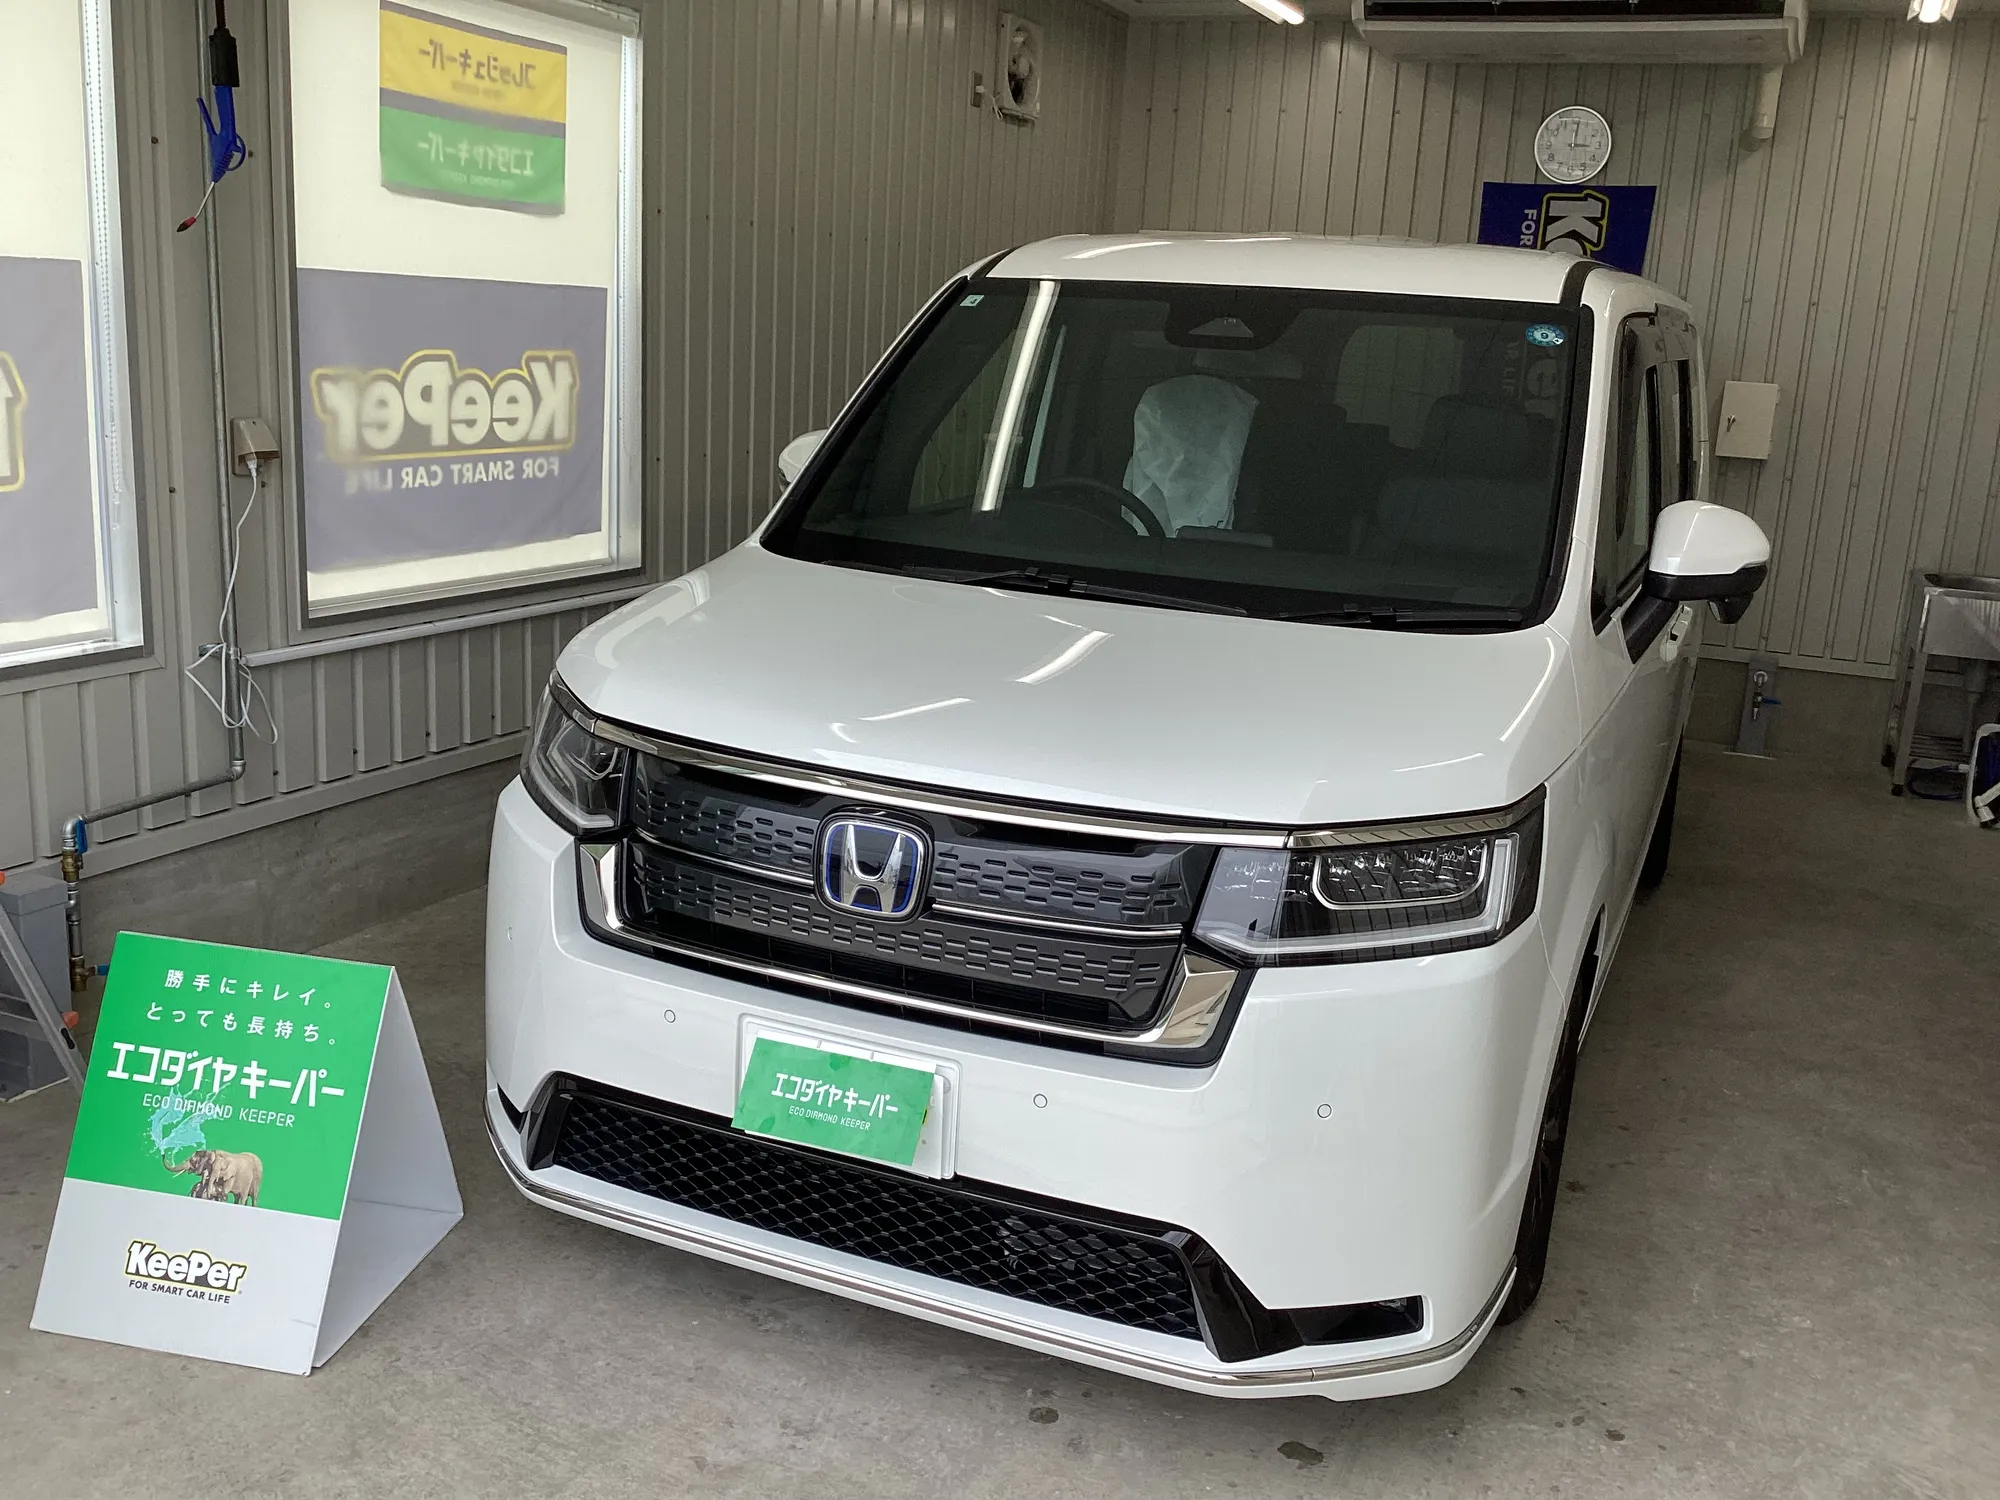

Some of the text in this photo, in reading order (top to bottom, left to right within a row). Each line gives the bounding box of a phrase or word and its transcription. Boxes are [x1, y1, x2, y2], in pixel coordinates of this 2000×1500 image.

[1519, 209, 1538, 246] FOR
[164, 969, 331, 1009] 勝手にキレイ。
[146, 1001, 336, 1045] とっても長持ち。
[106, 1041, 345, 1108] エコダイヤキーパー
[142, 1093, 295, 1128] ECO DIAMOND KEEPER
[771, 1072, 899, 1119] エコダイヤキーパー
[788, 1105, 871, 1131] ECO DIAMOND KEEPER
[125, 1239, 247, 1293] KeePer
[128, 1279, 231, 1304] FOR SMART CAR LIFE
